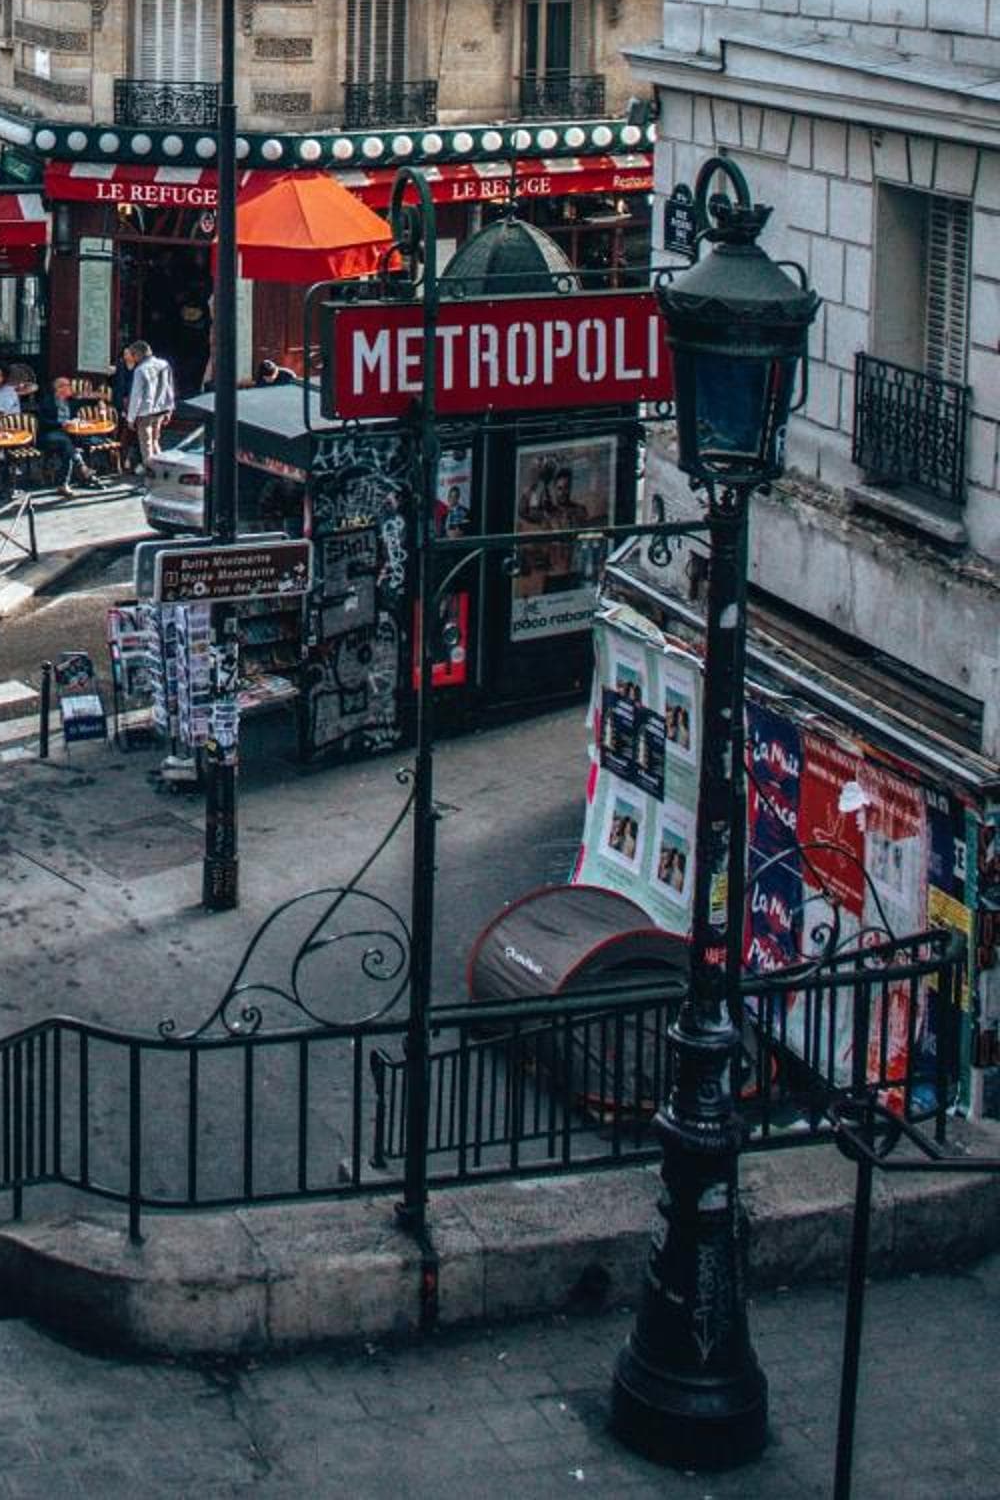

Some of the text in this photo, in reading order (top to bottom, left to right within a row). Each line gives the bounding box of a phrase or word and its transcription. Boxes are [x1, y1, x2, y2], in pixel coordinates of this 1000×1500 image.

[96, 183, 217, 205] LE REFUGE
[452, 181, 476, 200] LE
[352, 315, 659, 396] METROPOLI
[213, 553, 272, 567] Montmartre
[218, 567, 275, 580] Montmartre
[513, 617, 547, 631] paco
